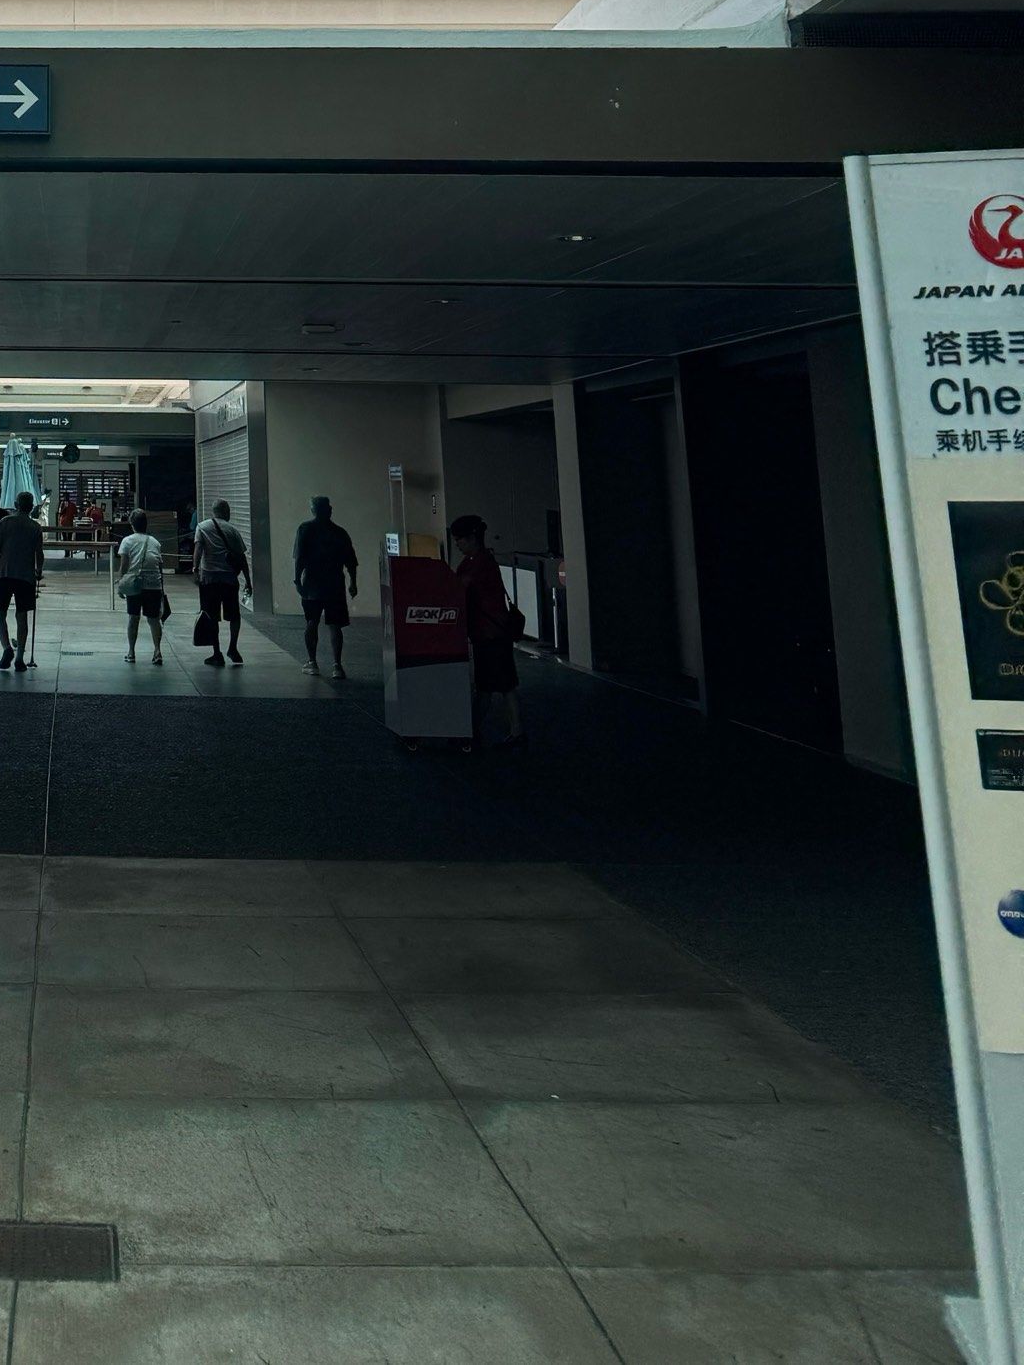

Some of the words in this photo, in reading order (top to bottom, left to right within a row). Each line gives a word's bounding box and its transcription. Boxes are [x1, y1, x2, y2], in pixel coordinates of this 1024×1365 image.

[913, 284, 995, 299] JAPAN
[930, 377, 1022, 416] Che
[408, 609, 439, 619] LOOK
[999, 910, 1024, 919] one
